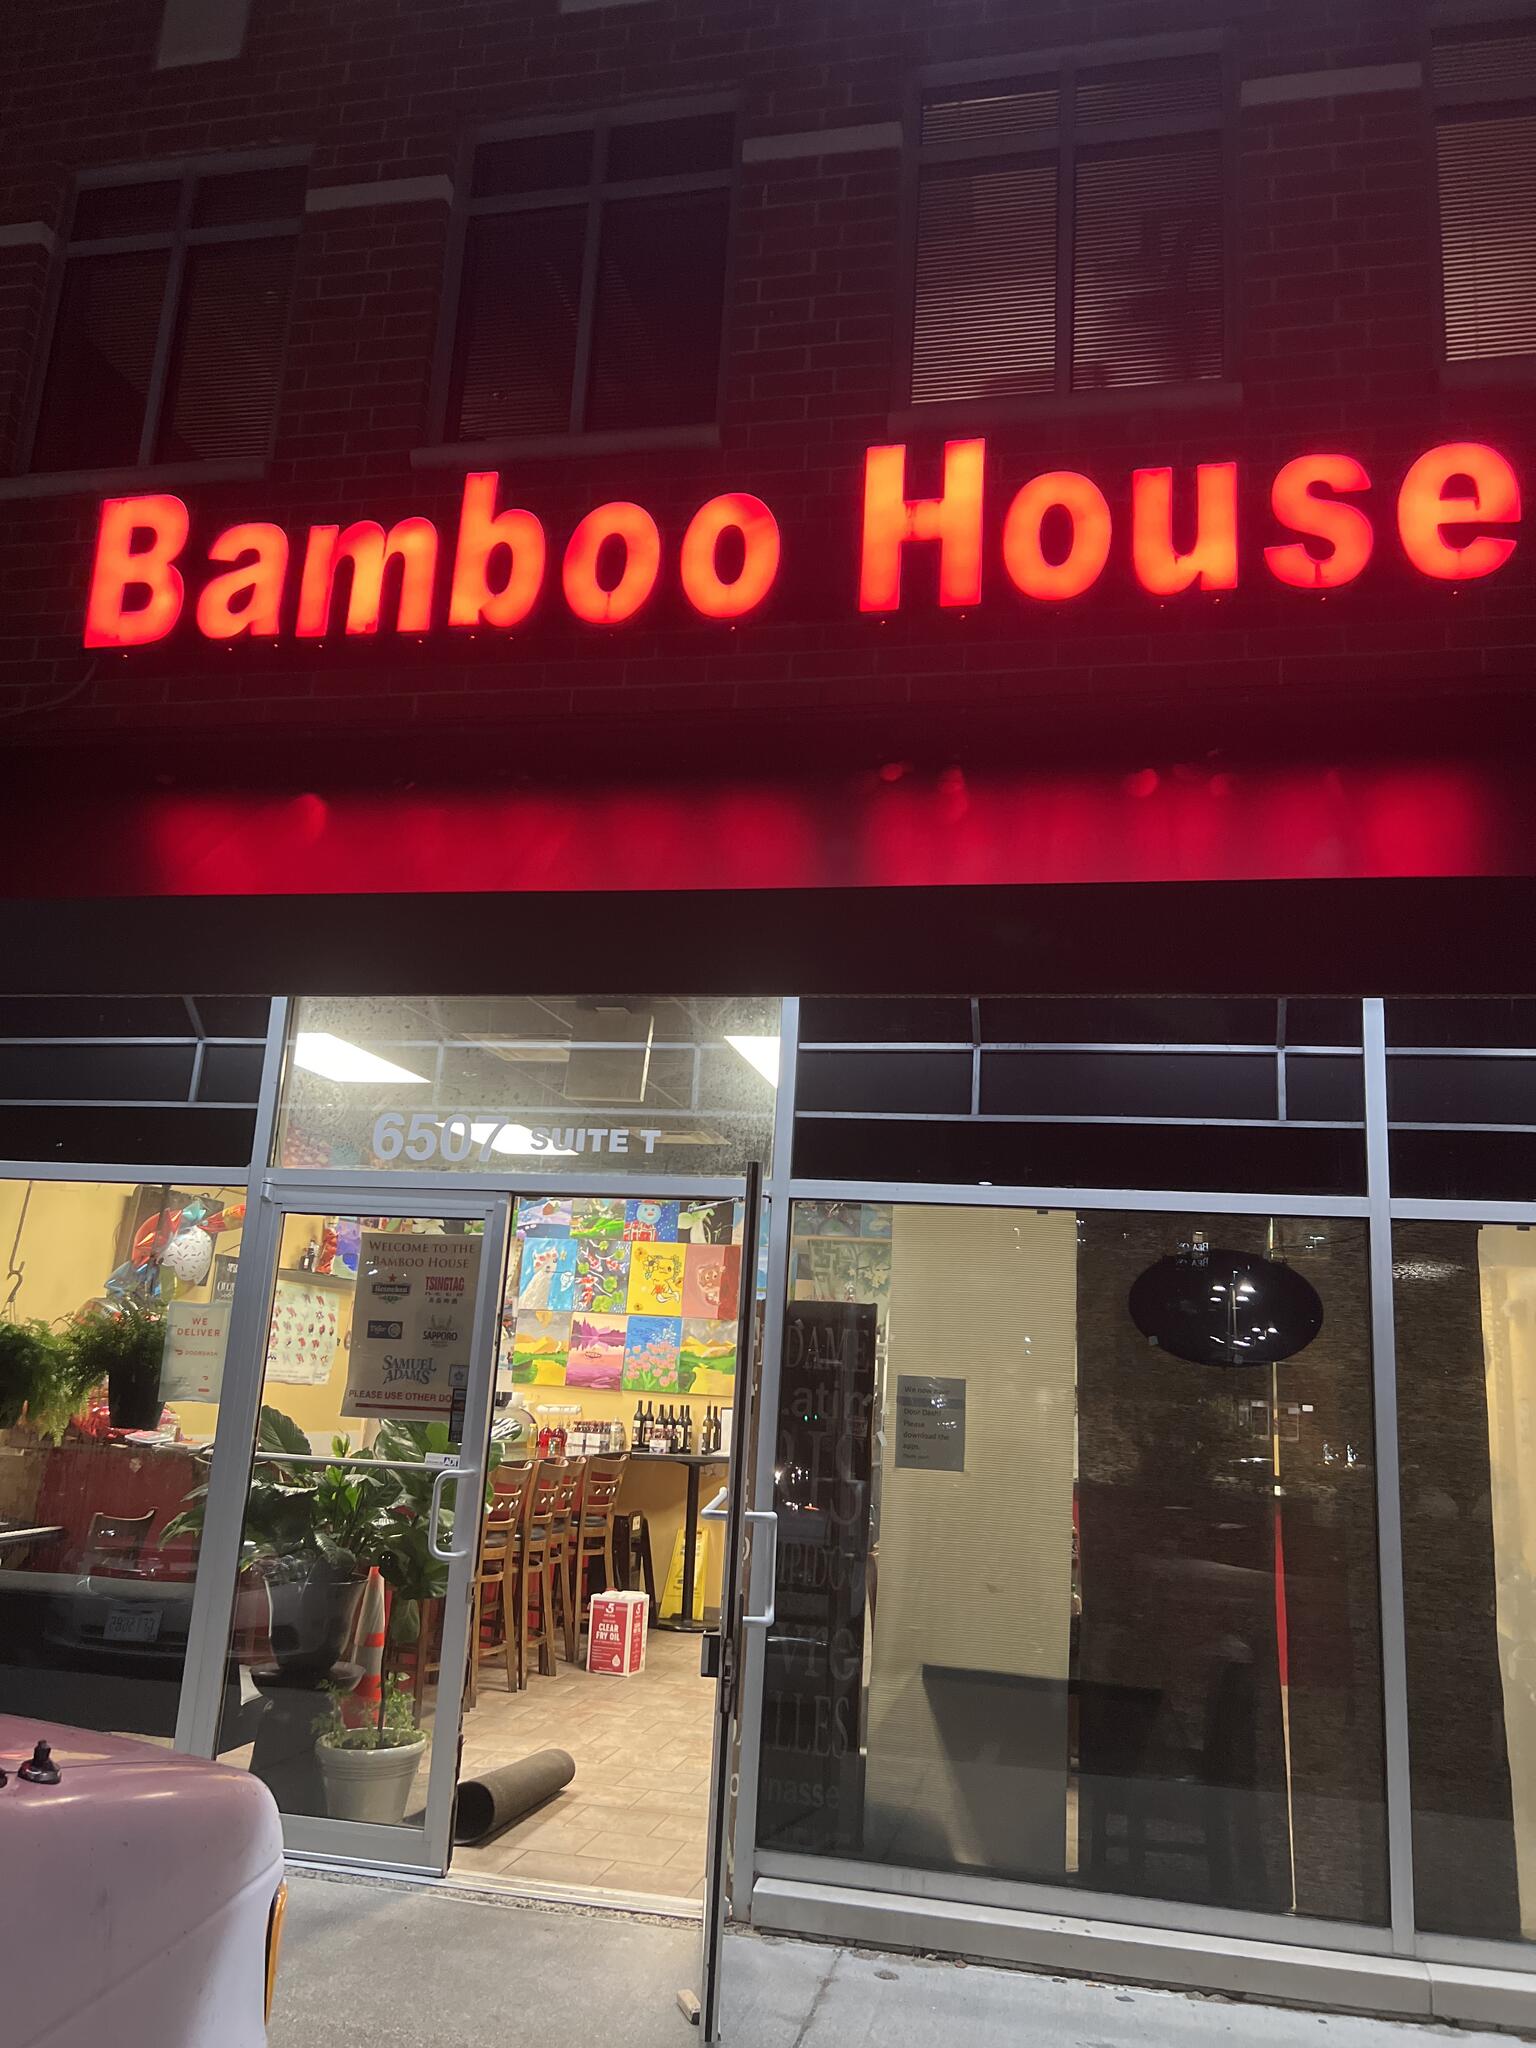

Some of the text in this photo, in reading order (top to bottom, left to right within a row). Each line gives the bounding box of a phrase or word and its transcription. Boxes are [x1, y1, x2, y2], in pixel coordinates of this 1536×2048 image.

[84, 438, 1521, 649] Bamboo House
[372, 1112, 662, 1162] 6507 SUITE T
[369, 1240, 475, 1253] WELCOME TO THE
[373, 1255, 469, 1269] BAMBOO HOUSE
[192, 1318, 208, 1326] WE
[177, 1328, 221, 1337] DELIVER
[422, 1330, 458, 1342] SAPPORO
[783, 1324, 870, 1374] DAME
[382, 1355, 437, 1372] SAMUEL
[383, 1368, 431, 1385] ADAMS
[349, 1389, 383, 1399] PLEASE
[385, 1391, 403, 1400] USE
[405, 1392, 436, 1402] OTHER
[781, 1380, 866, 1421] atin
[598, 1622, 619, 1633] CLEAR
[596, 1631, 620, 1641] FRY OIL
[767, 1690, 850, 1759] LLES
